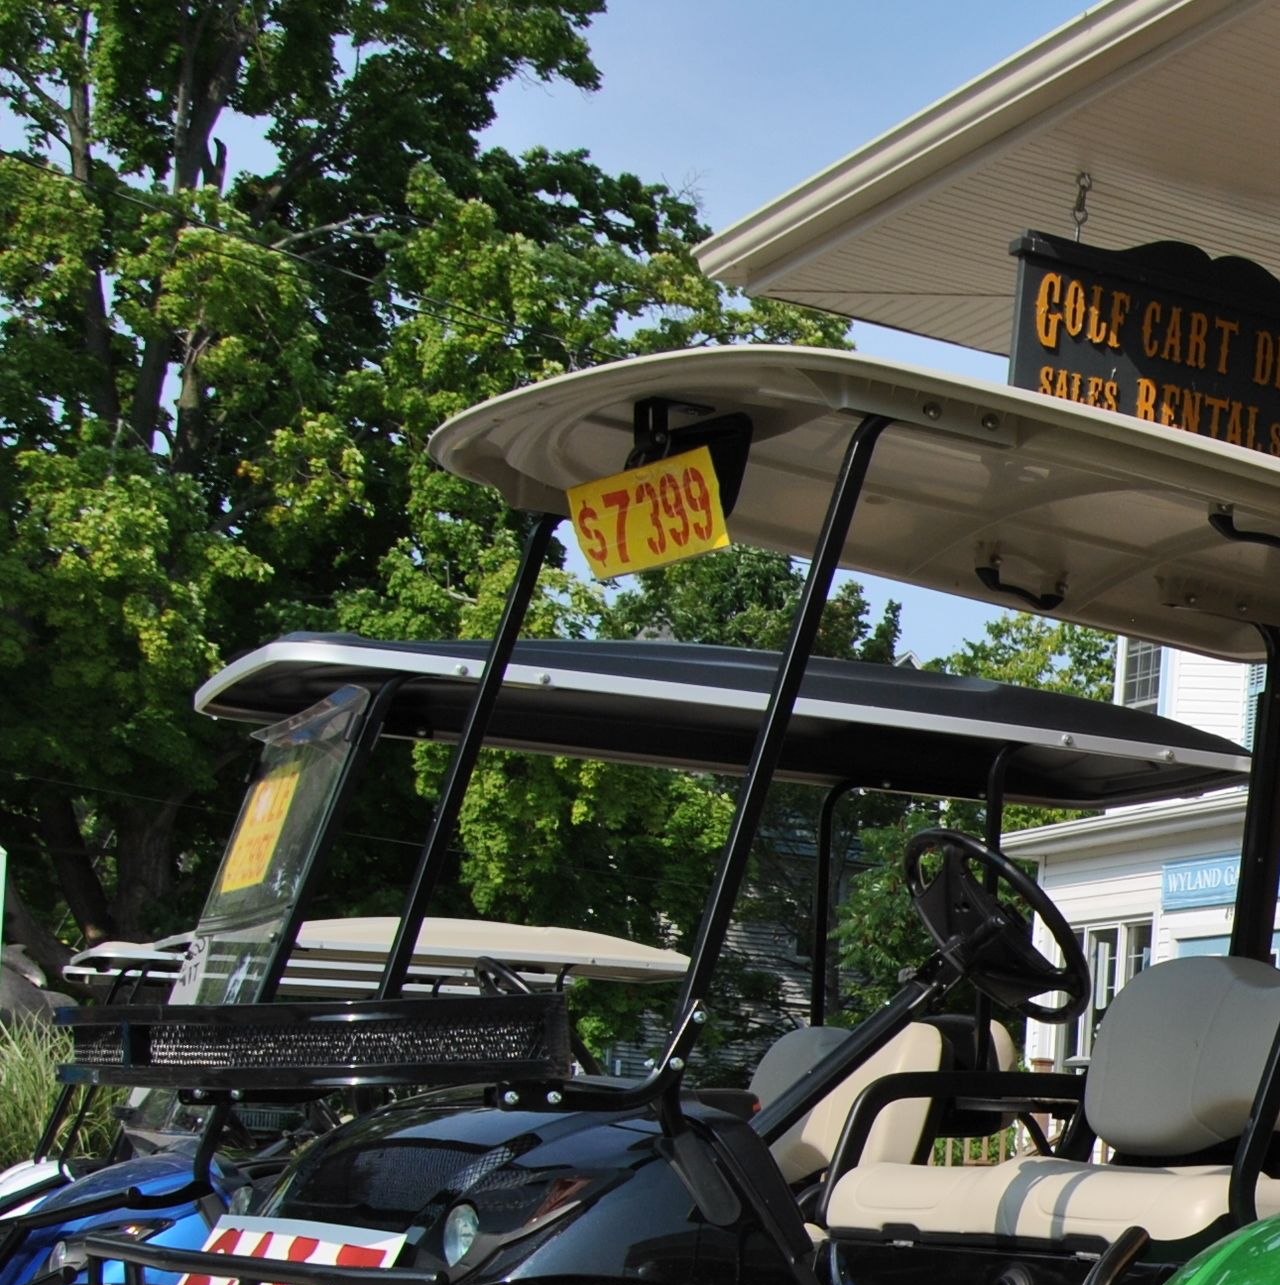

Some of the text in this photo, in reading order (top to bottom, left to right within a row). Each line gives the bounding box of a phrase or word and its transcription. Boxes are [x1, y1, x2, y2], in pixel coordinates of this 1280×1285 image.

[1035, 272, 1131, 348] GOLF
[1142, 301, 1239, 376] CART
[1038, 365, 1118, 412] SALES
[1136, 377, 1262, 449] RENTAL
[578, 467, 713, 567] $7399
[1167, 867, 1222, 893] WYLAND
